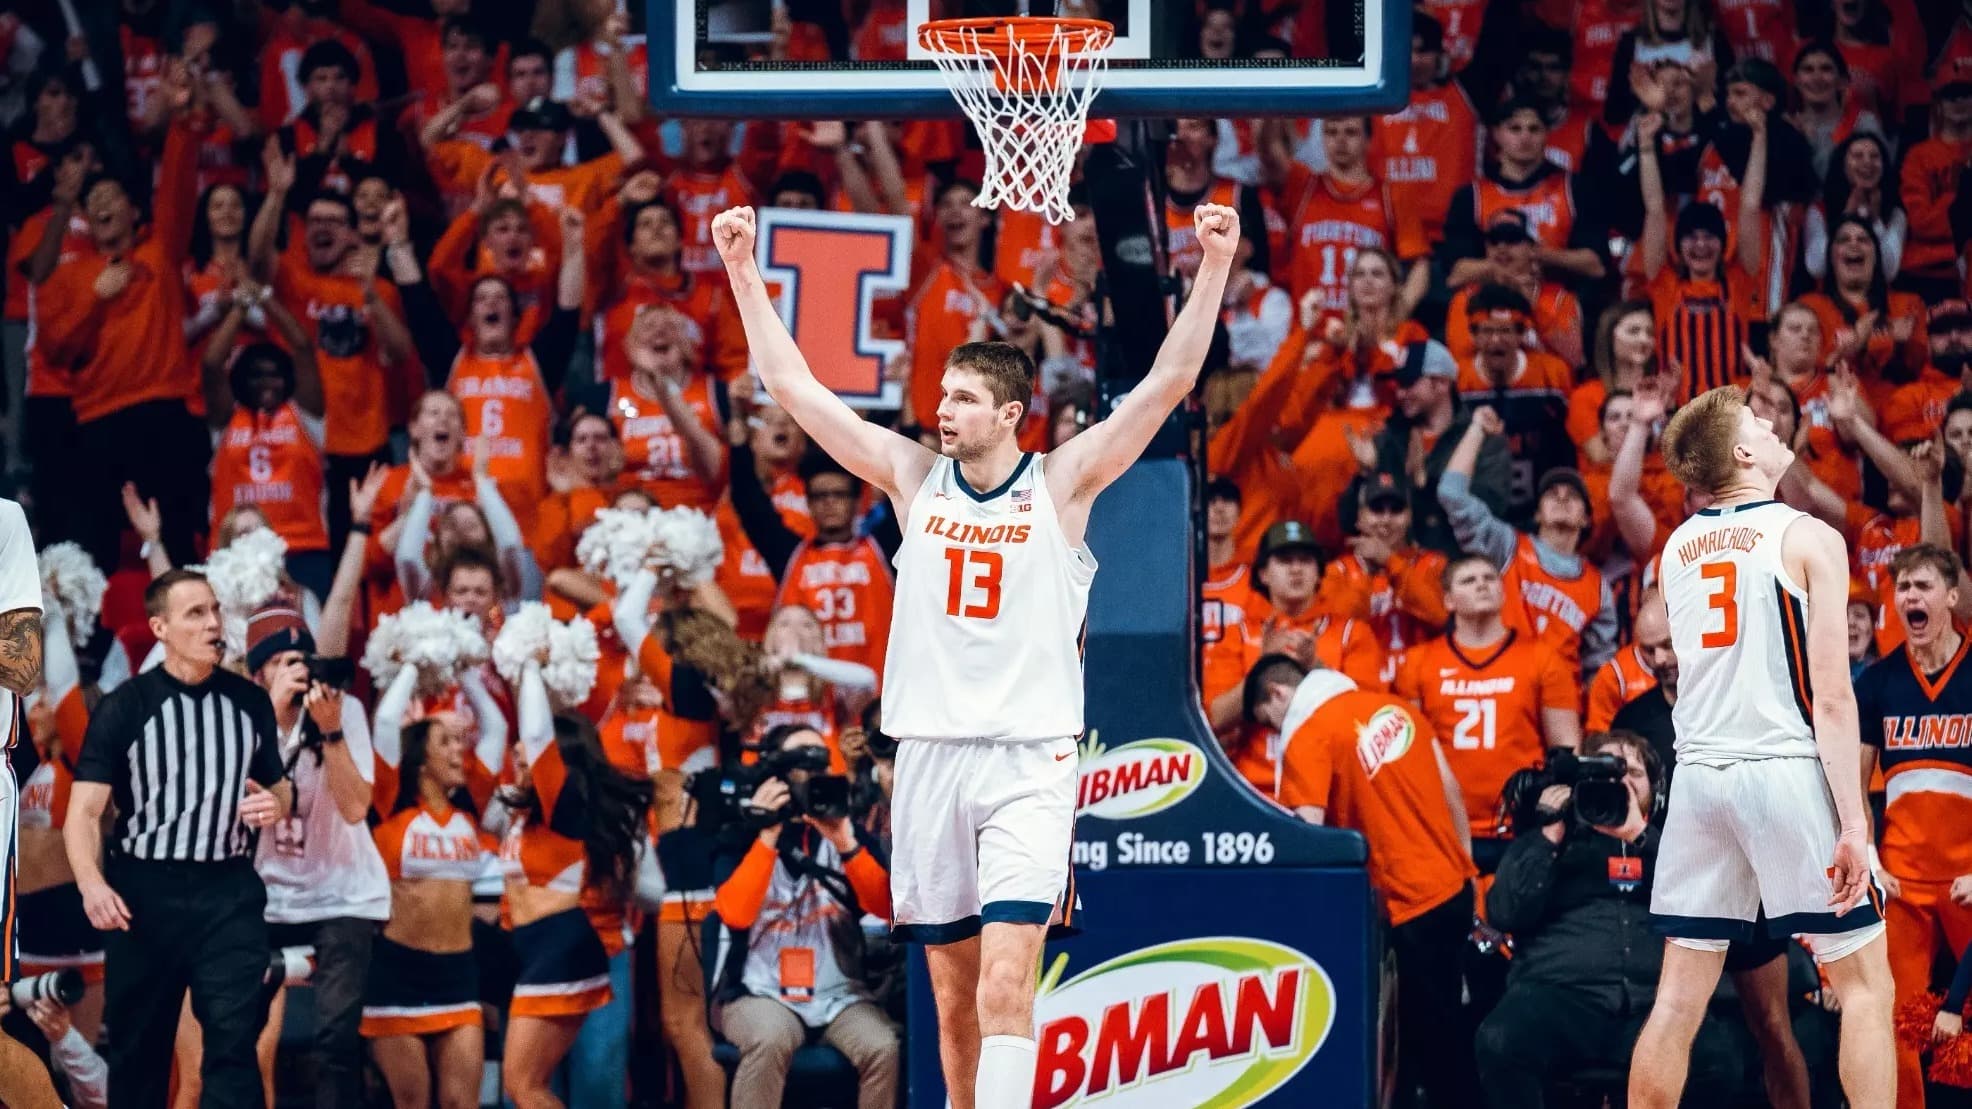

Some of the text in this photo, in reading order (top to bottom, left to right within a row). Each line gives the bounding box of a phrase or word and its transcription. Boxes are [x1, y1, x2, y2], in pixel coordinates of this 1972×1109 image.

[924, 515, 1031, 544] ILLINOIS
[1678, 527, 1764, 567] HUMRICHOUS
[815, 586, 856, 621] 33
[945, 547, 1004, 619] 13
[1701, 561, 1738, 649] 3
[1453, 699, 1497, 750] 21
[1883, 713, 1972, 751] ILLINOI
[1076, 753, 1191, 809] IBMAN
[1073, 832, 1275, 871] ng Since 1896
[1030, 967, 1300, 1109] BMAN
